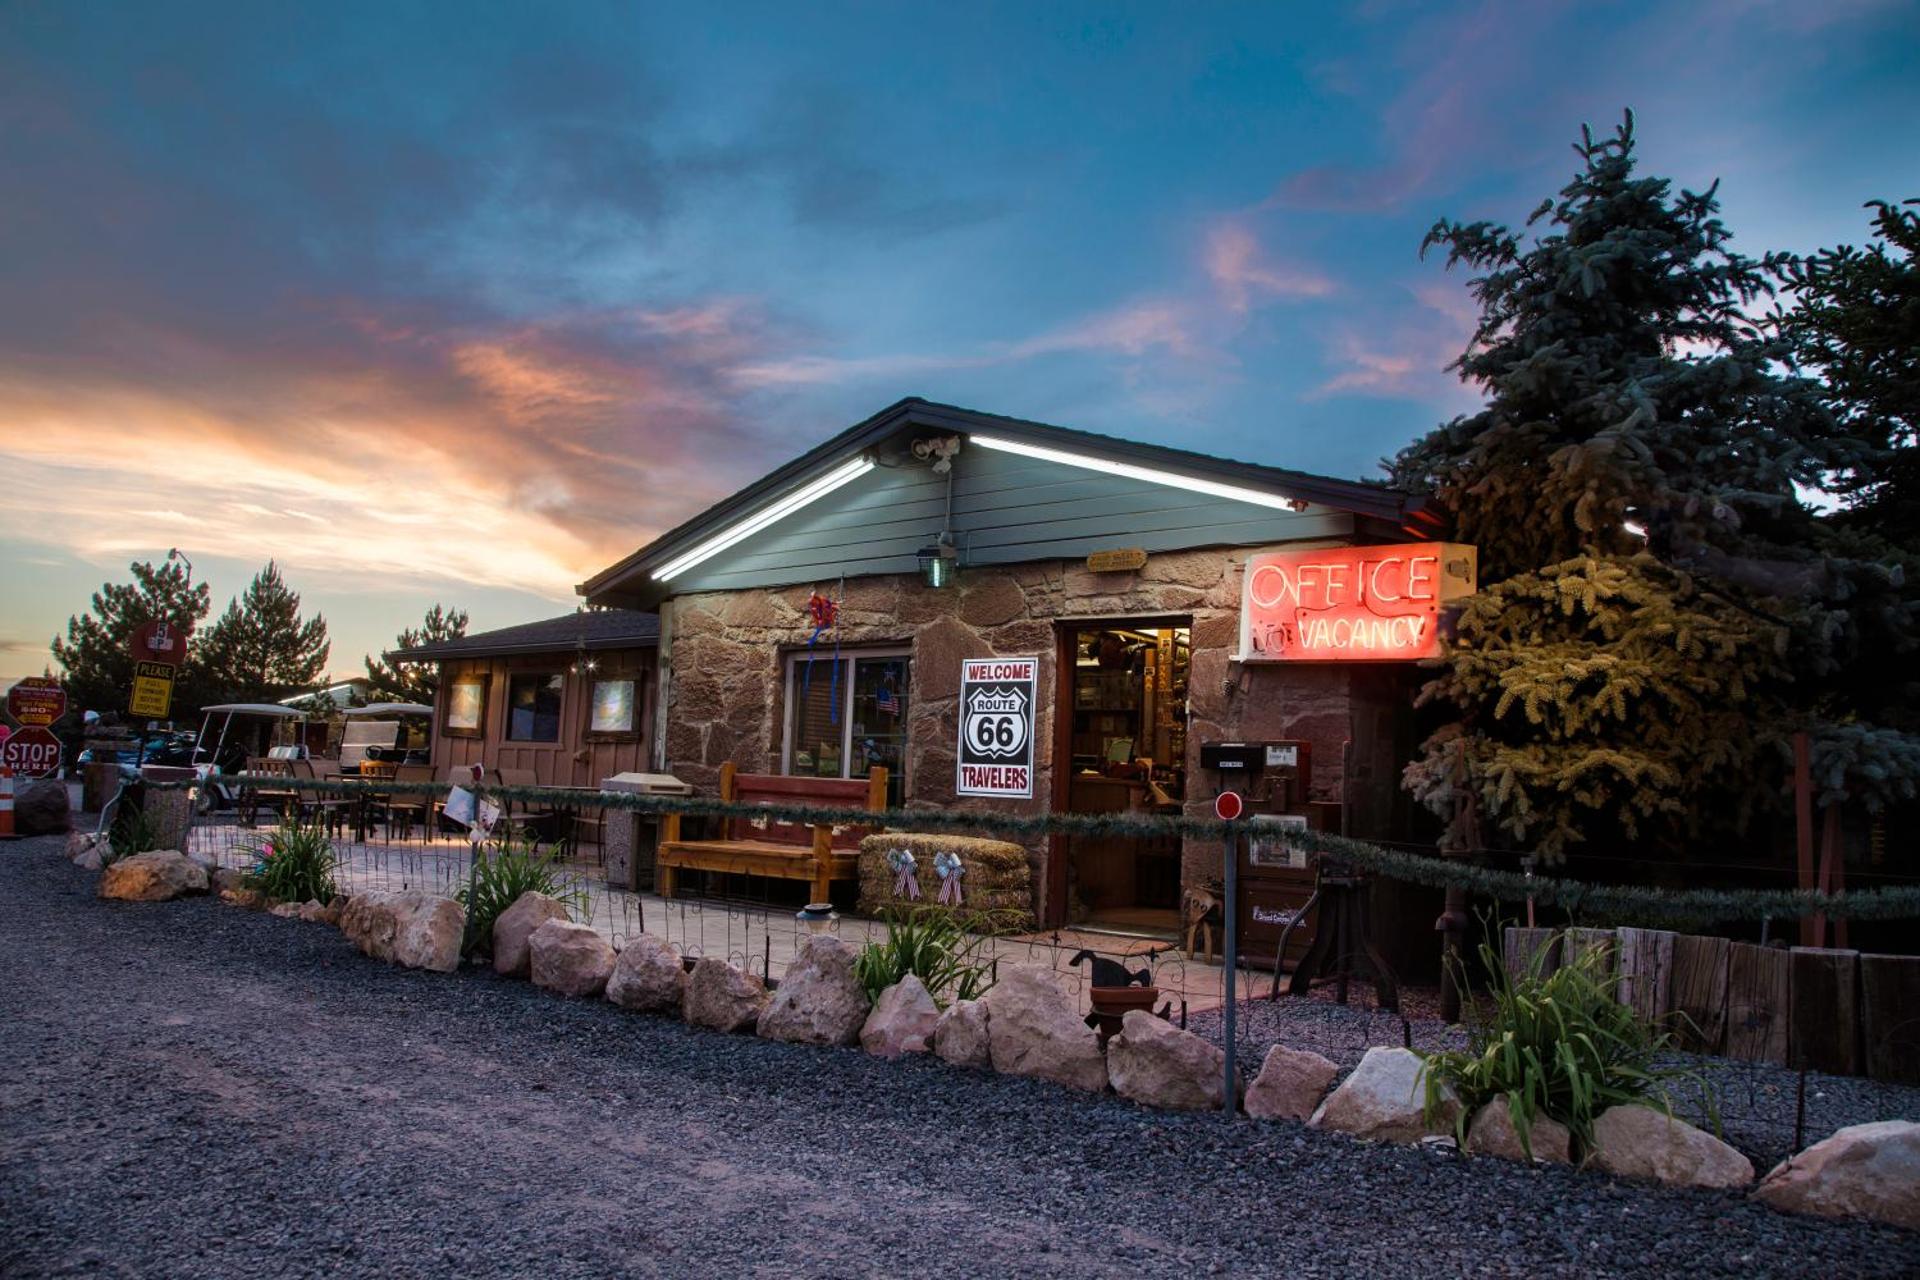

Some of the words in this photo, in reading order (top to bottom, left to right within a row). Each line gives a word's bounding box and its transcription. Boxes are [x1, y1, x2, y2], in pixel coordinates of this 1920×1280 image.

[1249, 556, 1437, 608] OFFICE
[1298, 614, 1426, 649] VACANCY
[140, 663, 173, 678] PLEASE
[968, 664, 1032, 681] WELCOME
[977, 699, 1016, 711] ROUTE
[977, 716, 1014, 747] 66
[6, 743, 58, 762] STOP
[11, 762, 52, 771] HERE
[962, 766, 1028, 790] TRAVELERS
